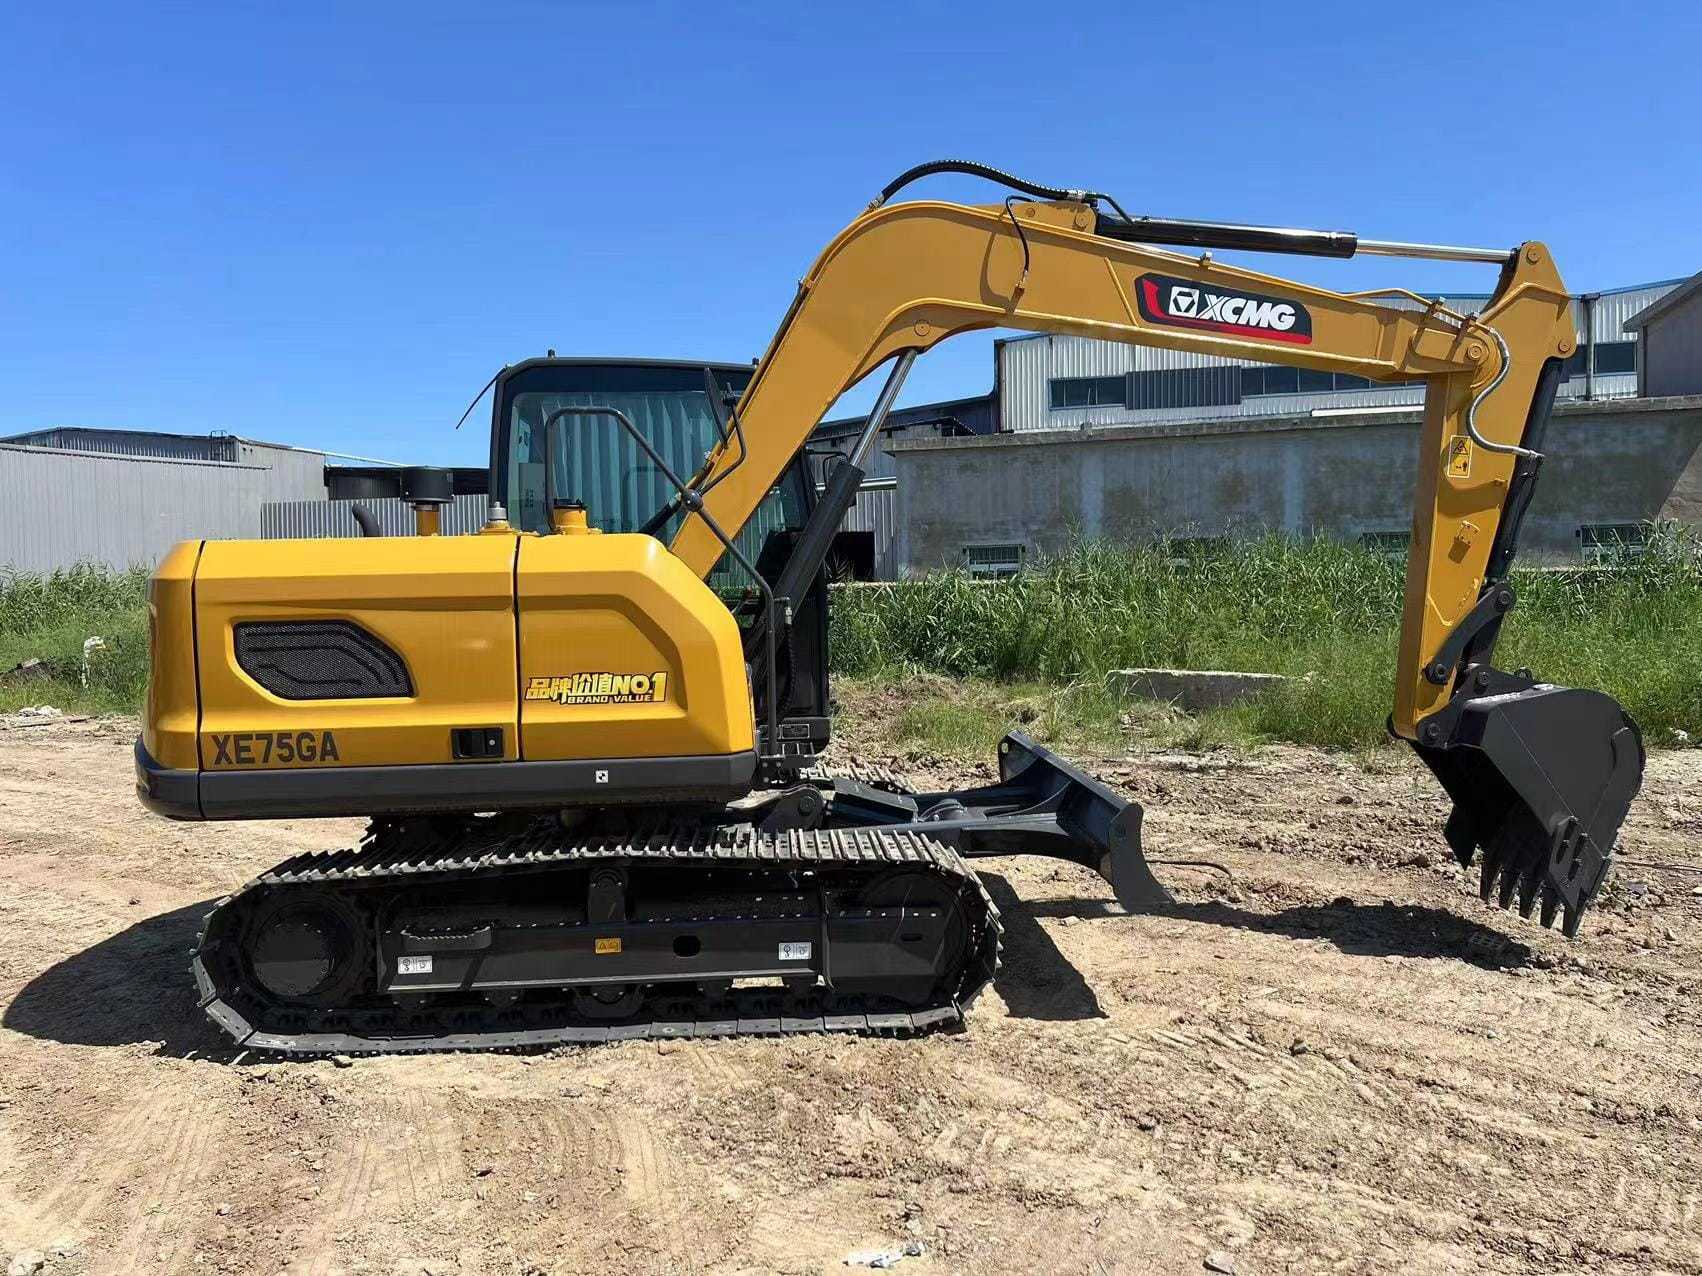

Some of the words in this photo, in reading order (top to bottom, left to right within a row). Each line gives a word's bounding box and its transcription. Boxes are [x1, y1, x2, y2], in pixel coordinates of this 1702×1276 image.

[1196, 293, 1296, 331] XCMG
[568, 695, 608, 704] BRAND
[615, 693, 651, 702] VALUE
[211, 731, 340, 765] XE75GA
